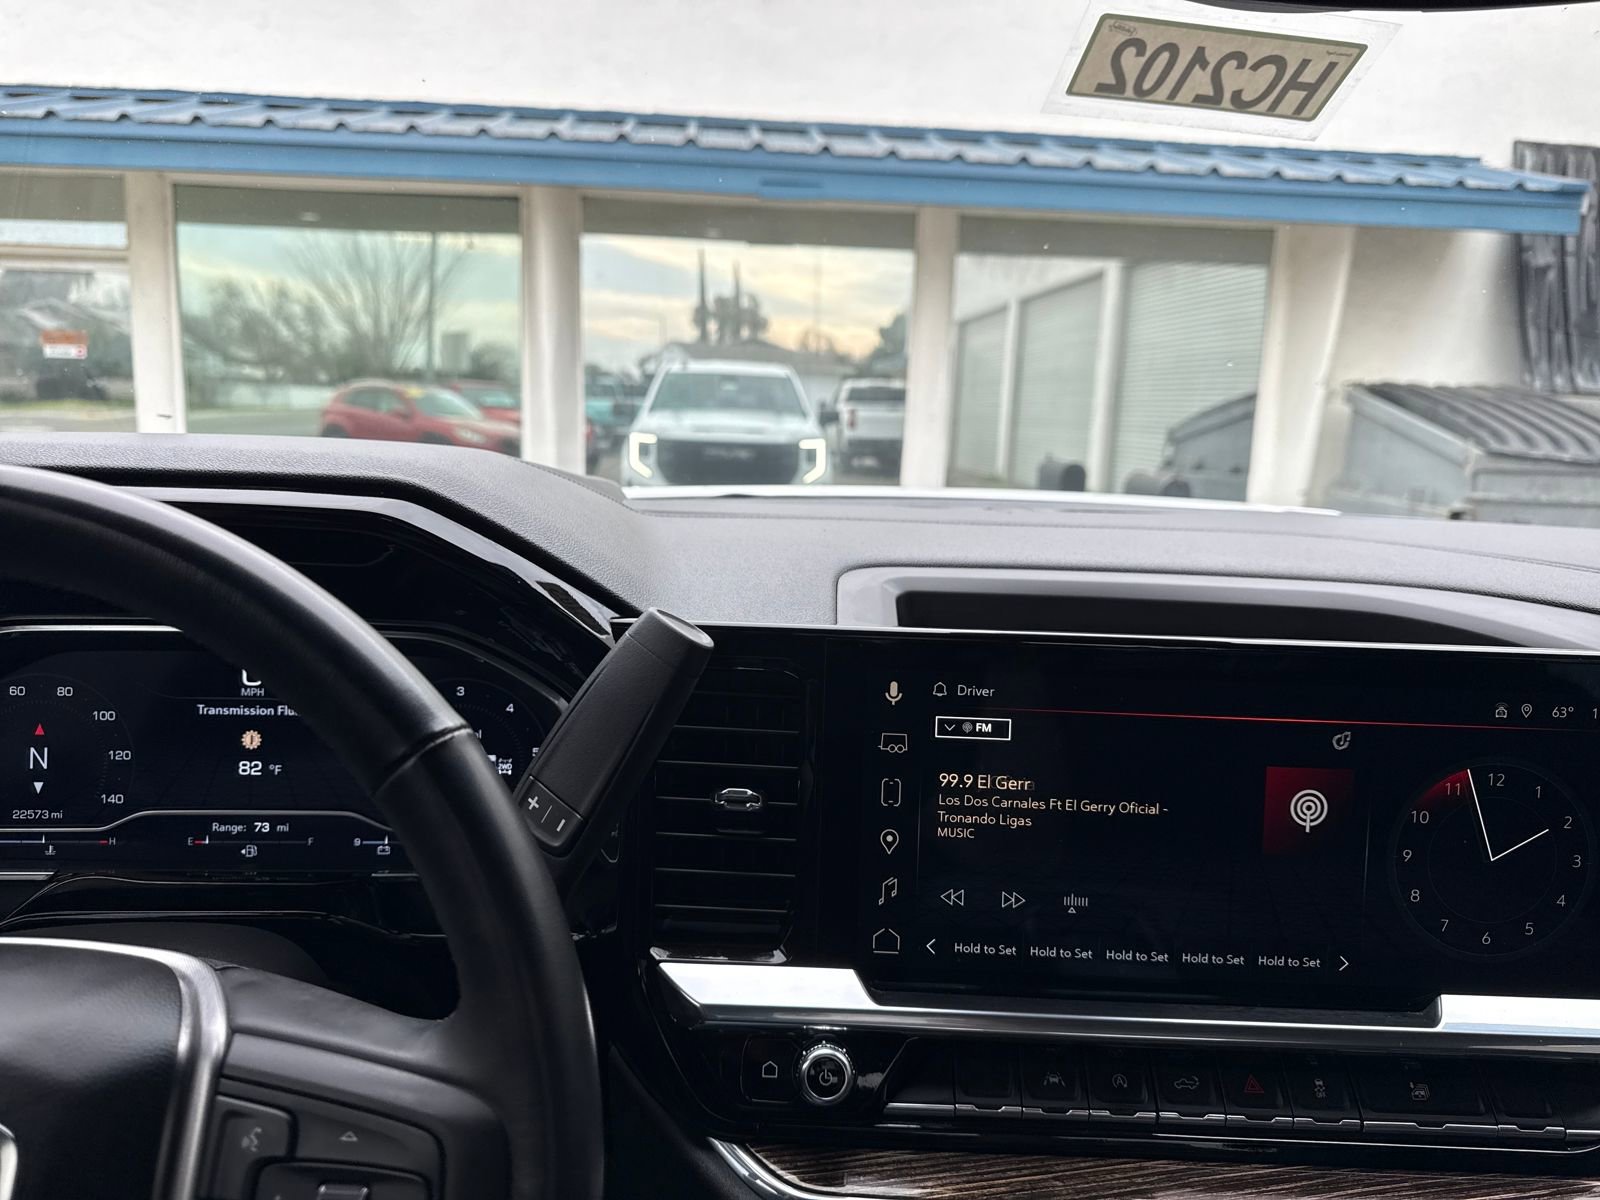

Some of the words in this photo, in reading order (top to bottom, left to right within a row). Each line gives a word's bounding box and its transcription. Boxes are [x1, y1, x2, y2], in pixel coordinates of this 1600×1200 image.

[9, 685, 26, 696] 60
[56, 686, 74, 697] 80
[240, 687, 265, 697] MPH
[456, 686, 465, 697] 3
[957, 684, 995, 697] Driver
[196, 704, 275, 716] Transmission
[505, 703, 514, 713] 4
[1551, 706, 1575, 718] 63°
[92, 710, 116, 721] 100
[975, 722, 992, 733] FM
[29, 746, 48, 770] N
[108, 750, 132, 761] 120
[238, 760, 263, 776] 82
[939, 772, 974, 788] 99.9
[977, 774, 991, 789] El
[1488, 773, 1505, 787] 12
[1445, 782, 1461, 796] 11
[1535, 785, 1541, 799] 1
[101, 793, 124, 804] 140
[938, 793, 961, 806] Los
[964, 794, 989, 807] Dos
[991, 795, 1046, 810] Carnales
[1049, 798, 1062, 811] Ft
[1065, 799, 1077, 811] El
[1080, 799, 1116, 816] Gerry
[1118, 801, 1159, 815] Oficial
[12, 809, 49, 820] 22573
[51, 809, 63, 819] mi
[937, 810, 996, 825] Tronando
[999, 813, 1032, 829] Ligas
[1411, 810, 1430, 824] 10
[212, 822, 247, 835] Range:
[253, 822, 270, 833] 73
[276, 822, 289, 832] mi
[1563, 815, 1573, 829] 2
[937, 827, 975, 839] MUSIC
[108, 837, 116, 846] H
[187, 837, 194, 846] E
[307, 837, 314, 846] F
[1402, 849, 1412, 862] 9
[1572, 854, 1582, 868] 3
[1410, 889, 1420, 903] 8
[1556, 894, 1566, 907] 4
[1440, 919, 1449, 932] 7
[1524, 922, 1534, 936] 5
[1481, 931, 1491, 945] 6
[954, 942, 981, 954] Hold
[983, 944, 996, 954] to
[998, 944, 1017, 955] Set
[1030, 946, 1057, 958] Hold
[1059, 948, 1072, 958] to
[1074, 948, 1093, 959] Set
[1106, 949, 1133, 961] Hold
[1135, 951, 1148, 961] to
[1150, 951, 1169, 962] Set
[1182, 952, 1209, 964] Hold
[1211, 954, 1224, 964] to
[1226, 954, 1245, 965] Set
[1258, 955, 1285, 967] Hold
[1287, 957, 1300, 967] to
[1302, 957, 1321, 968] Set
